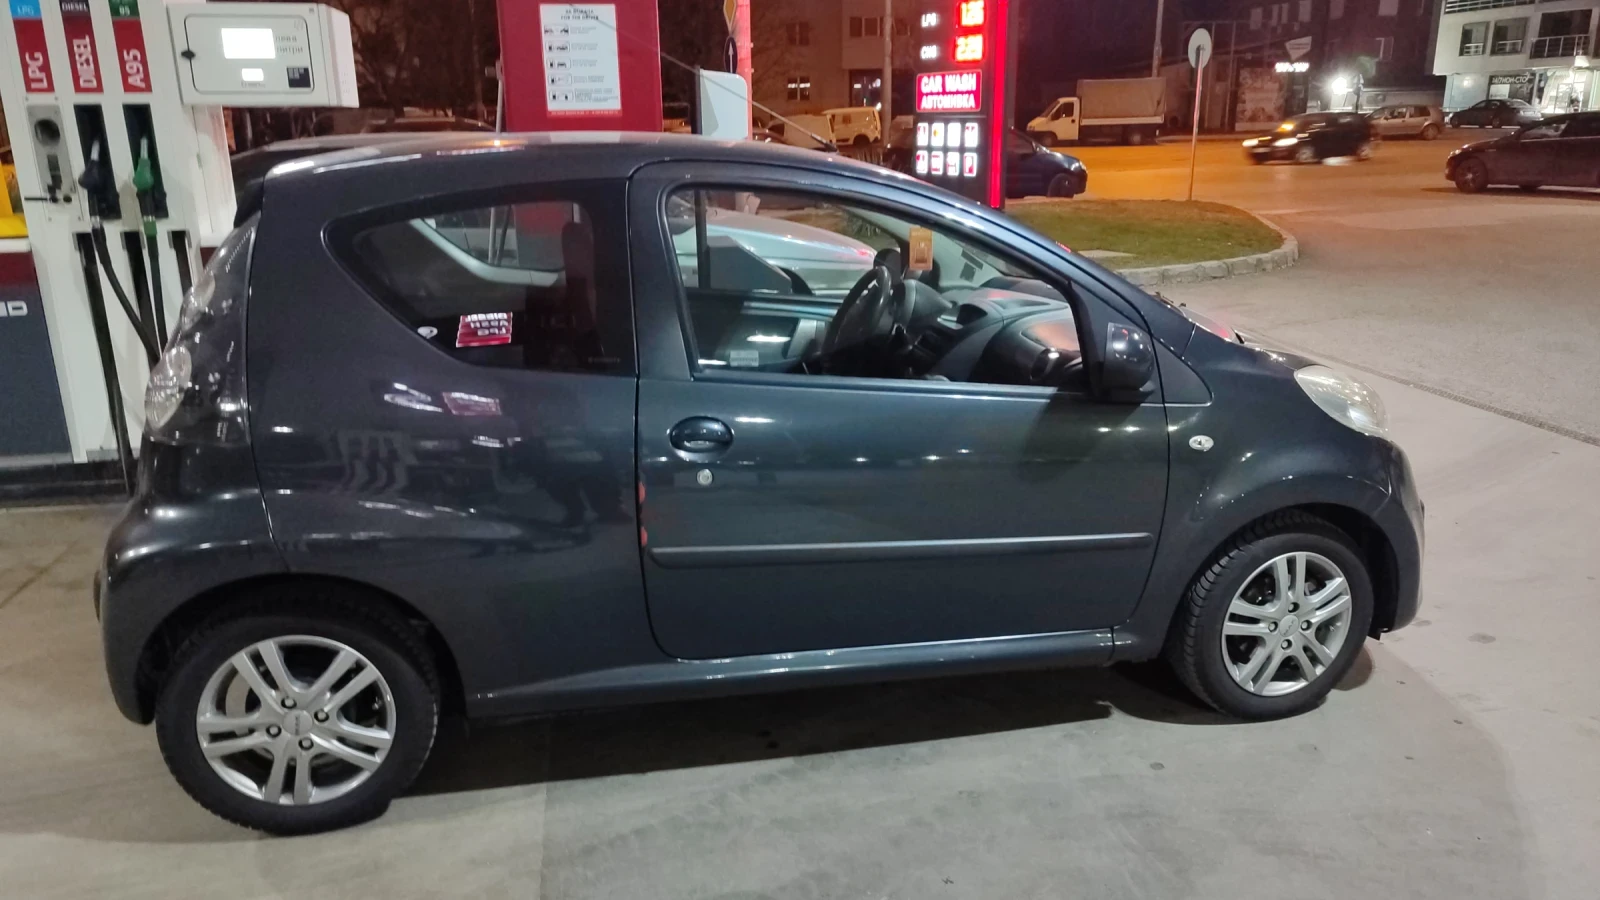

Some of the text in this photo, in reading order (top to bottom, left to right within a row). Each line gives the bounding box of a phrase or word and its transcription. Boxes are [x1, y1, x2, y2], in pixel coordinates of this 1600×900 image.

[17, 4, 34, 16] LPG
[61, 1, 88, 12] DIESEL
[921, 12, 937, 27] LPG
[25, 51, 48, 89] LPG
[72, 34, 98, 88] DIESEL
[123, 48, 146, 88] A95
[921, 73, 977, 93] CAR WASH
[921, 93, 976, 109] АВТОМИВКА
